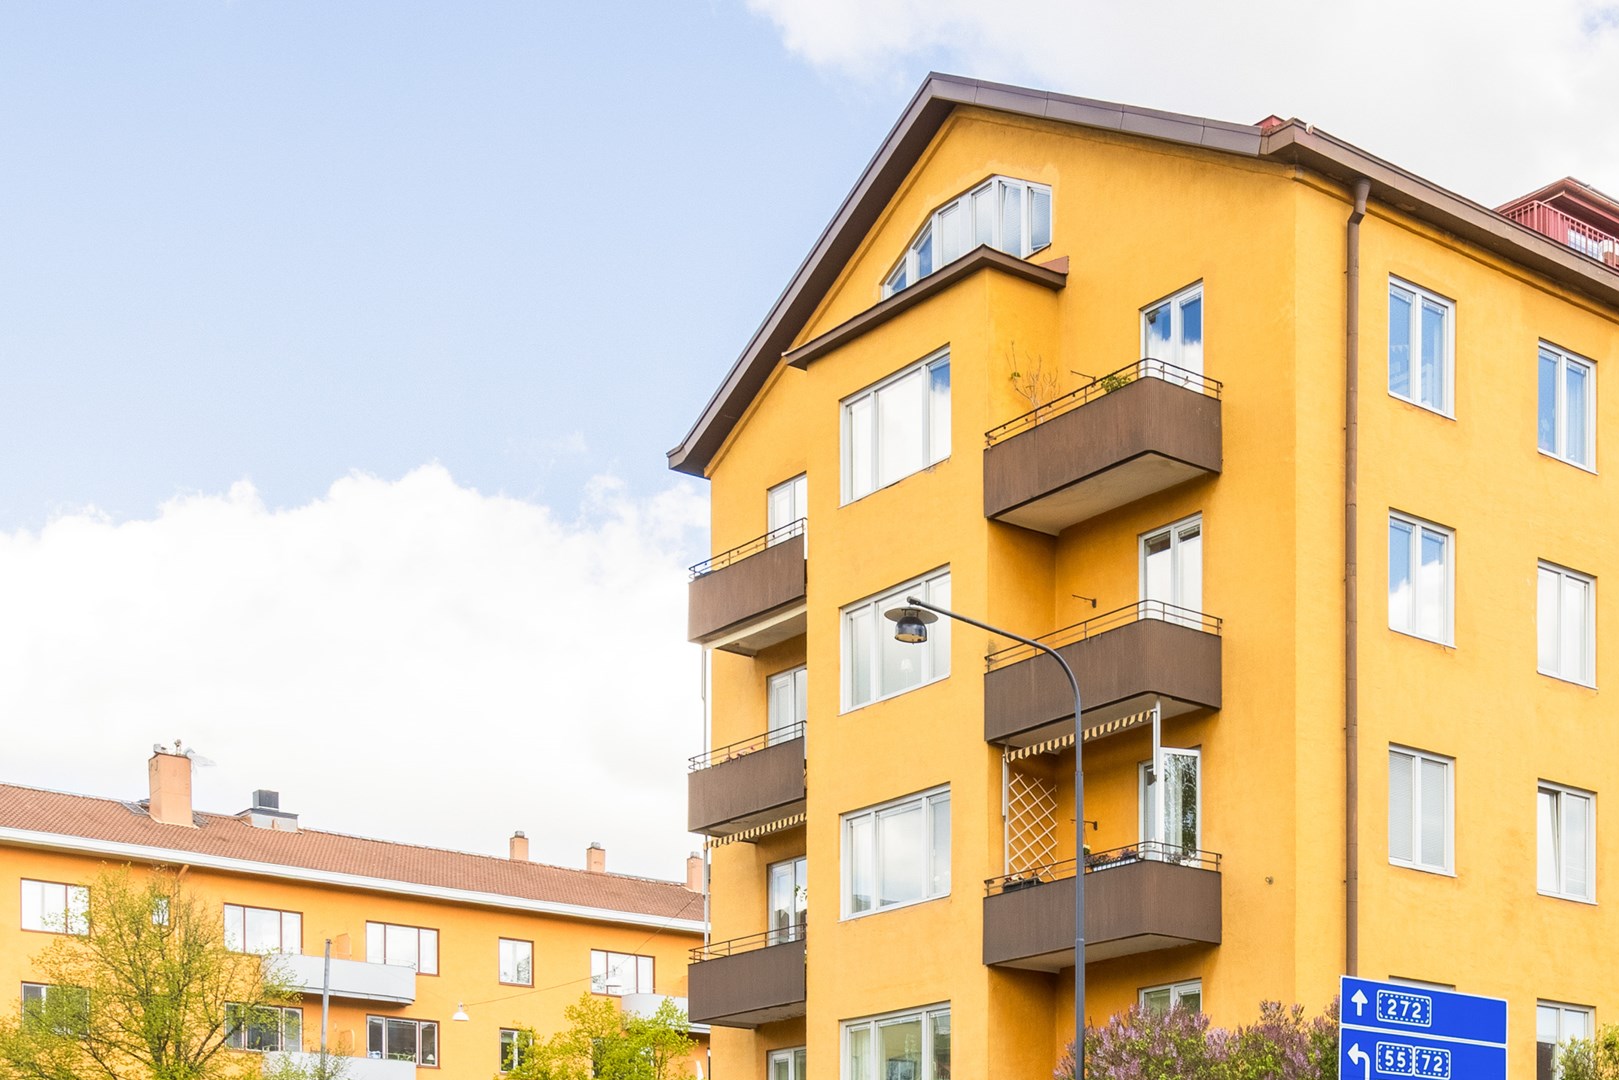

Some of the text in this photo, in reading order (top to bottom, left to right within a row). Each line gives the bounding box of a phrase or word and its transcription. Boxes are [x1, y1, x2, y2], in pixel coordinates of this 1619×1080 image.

[1387, 998, 1422, 1019] 272
[1384, 1049, 1443, 1073] 55 72
